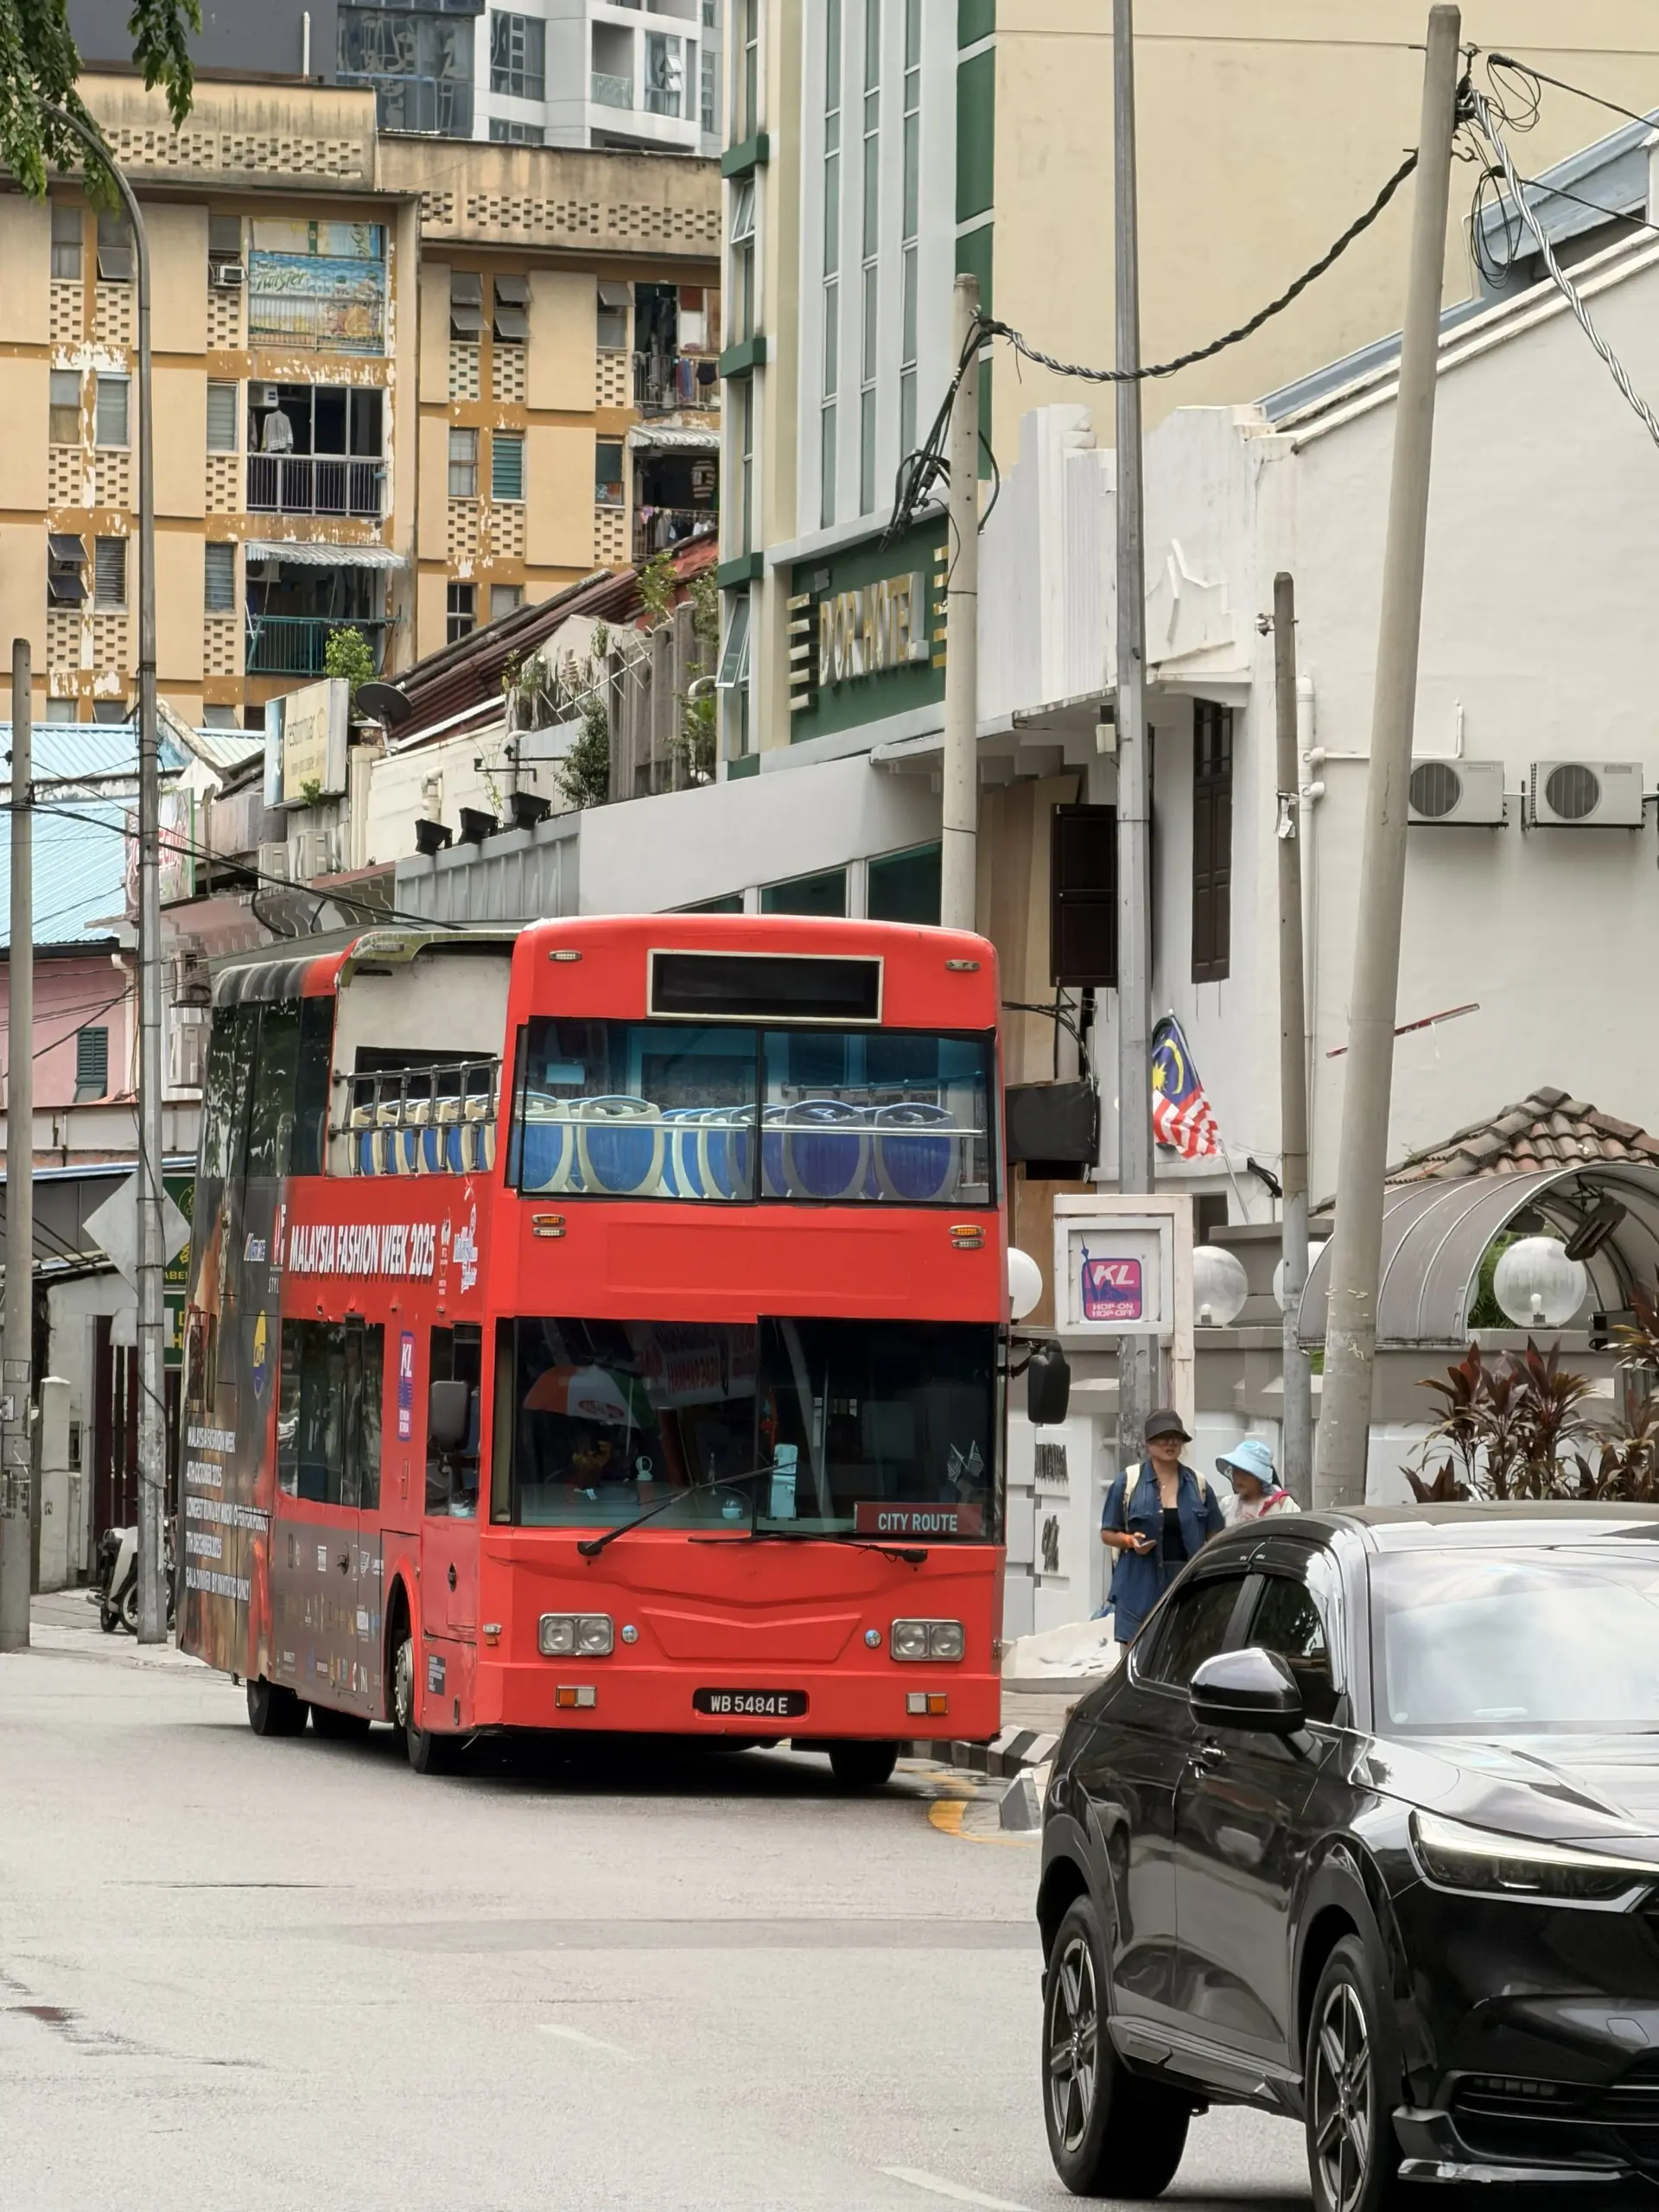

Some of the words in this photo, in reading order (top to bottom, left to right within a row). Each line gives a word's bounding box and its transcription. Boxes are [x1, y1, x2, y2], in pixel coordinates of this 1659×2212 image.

[289, 1224, 334, 1274] MALAYSIA
[335, 1224, 380, 1275] FASHION
[381, 1224, 410, 1274] WEEK
[408, 1223, 435, 1276] 2025
[1093, 1264, 1135, 1285] KL
[1092, 1302, 1134, 1311] HOP-ON
[1092, 1309, 1135, 1318] HOP-OFF
[400, 1344, 412, 1377] KL
[878, 1513, 909, 1531] CITY
[912, 1513, 958, 1532] ROUTE
